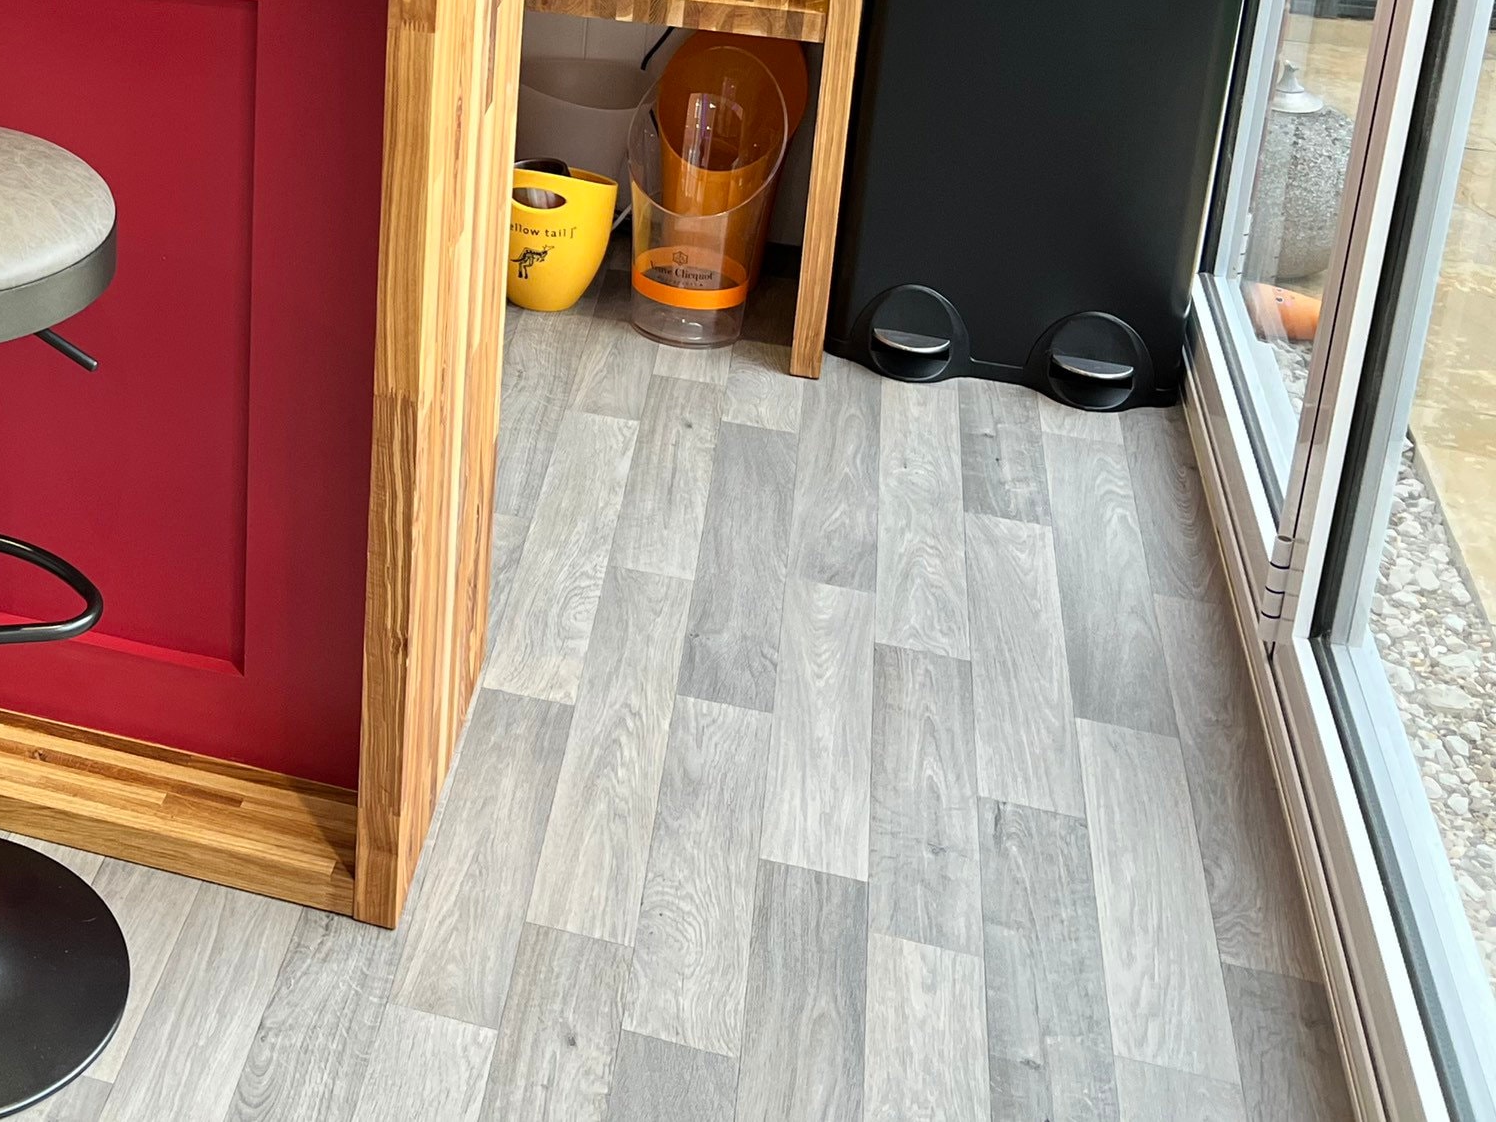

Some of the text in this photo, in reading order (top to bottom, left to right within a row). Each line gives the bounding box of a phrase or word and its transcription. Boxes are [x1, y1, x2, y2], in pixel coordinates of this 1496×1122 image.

[510, 223, 567, 238] ellow tail
[674, 268, 713, 282] Clicquot
